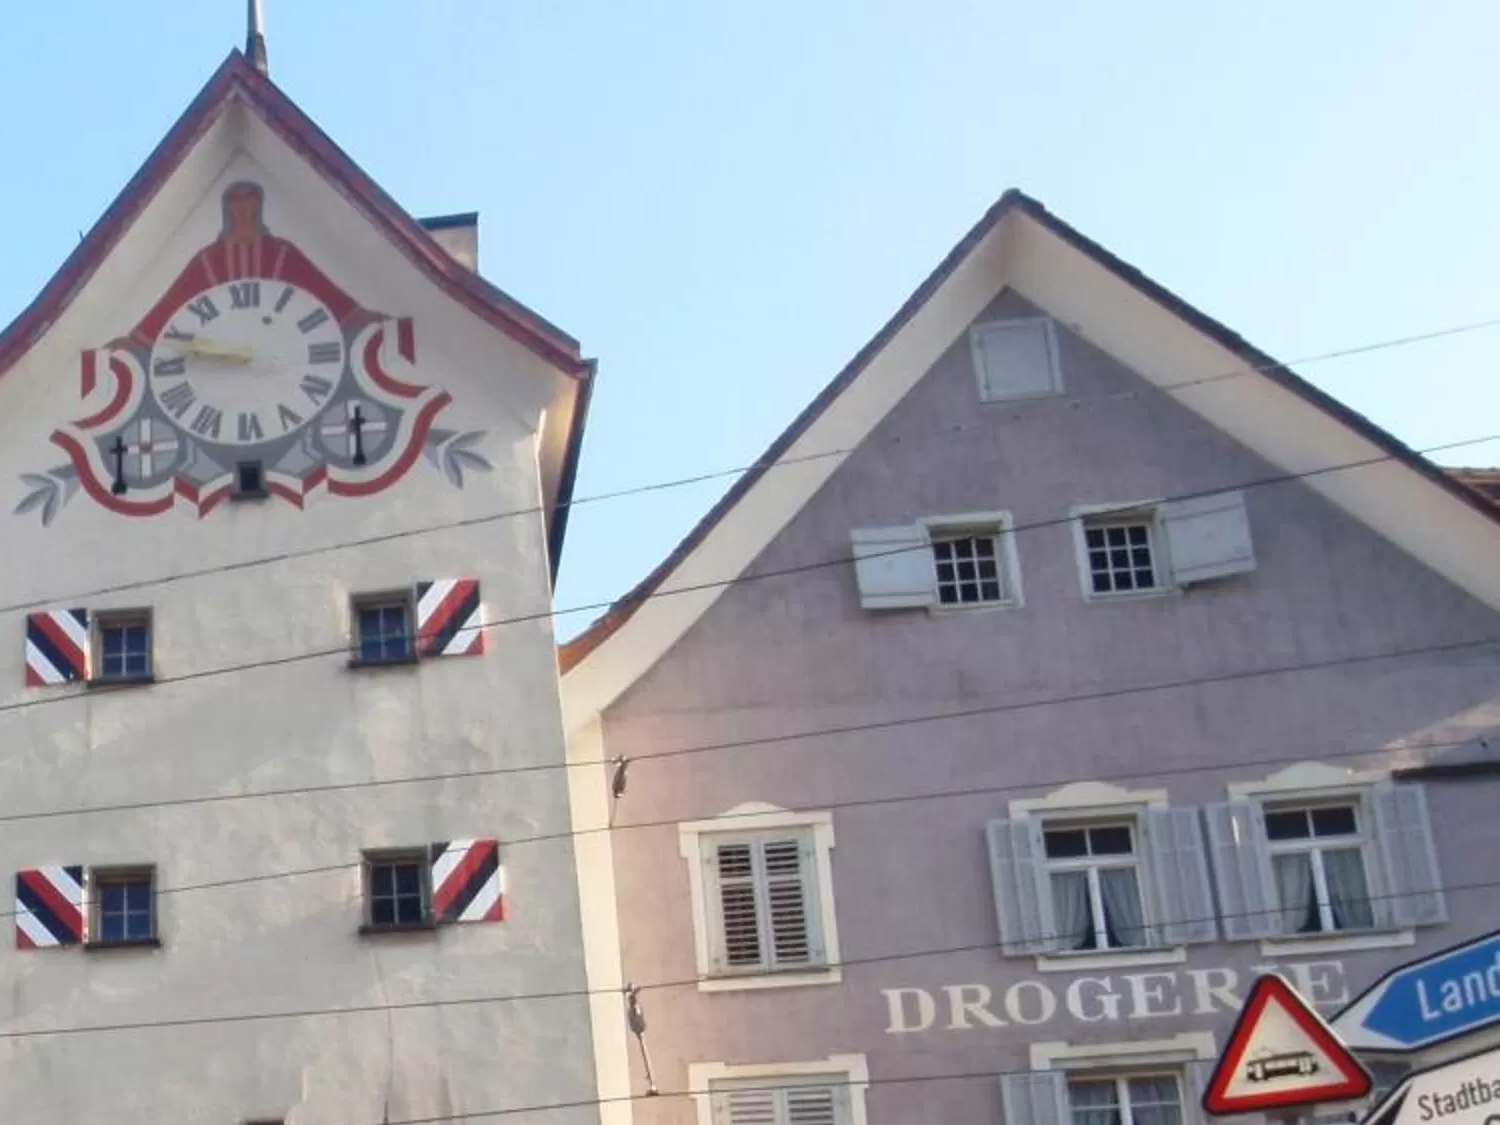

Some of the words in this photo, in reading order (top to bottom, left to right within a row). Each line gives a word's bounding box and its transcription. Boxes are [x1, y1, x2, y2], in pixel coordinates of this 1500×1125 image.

[187, 295, 220, 326] XI
[228, 282, 260, 310] XII
[274, 287, 295, 313] I
[297, 307, 329, 335] II
[153, 356, 186, 377] IX
[308, 342, 341, 365] III
[159, 380, 197, 419] VIII
[299, 373, 333, 406] IV
[189, 404, 224, 440] VII
[238, 411, 265, 441] VI
[276, 403, 303, 432] V
[880, 959, 1349, 1034] DROGERE
